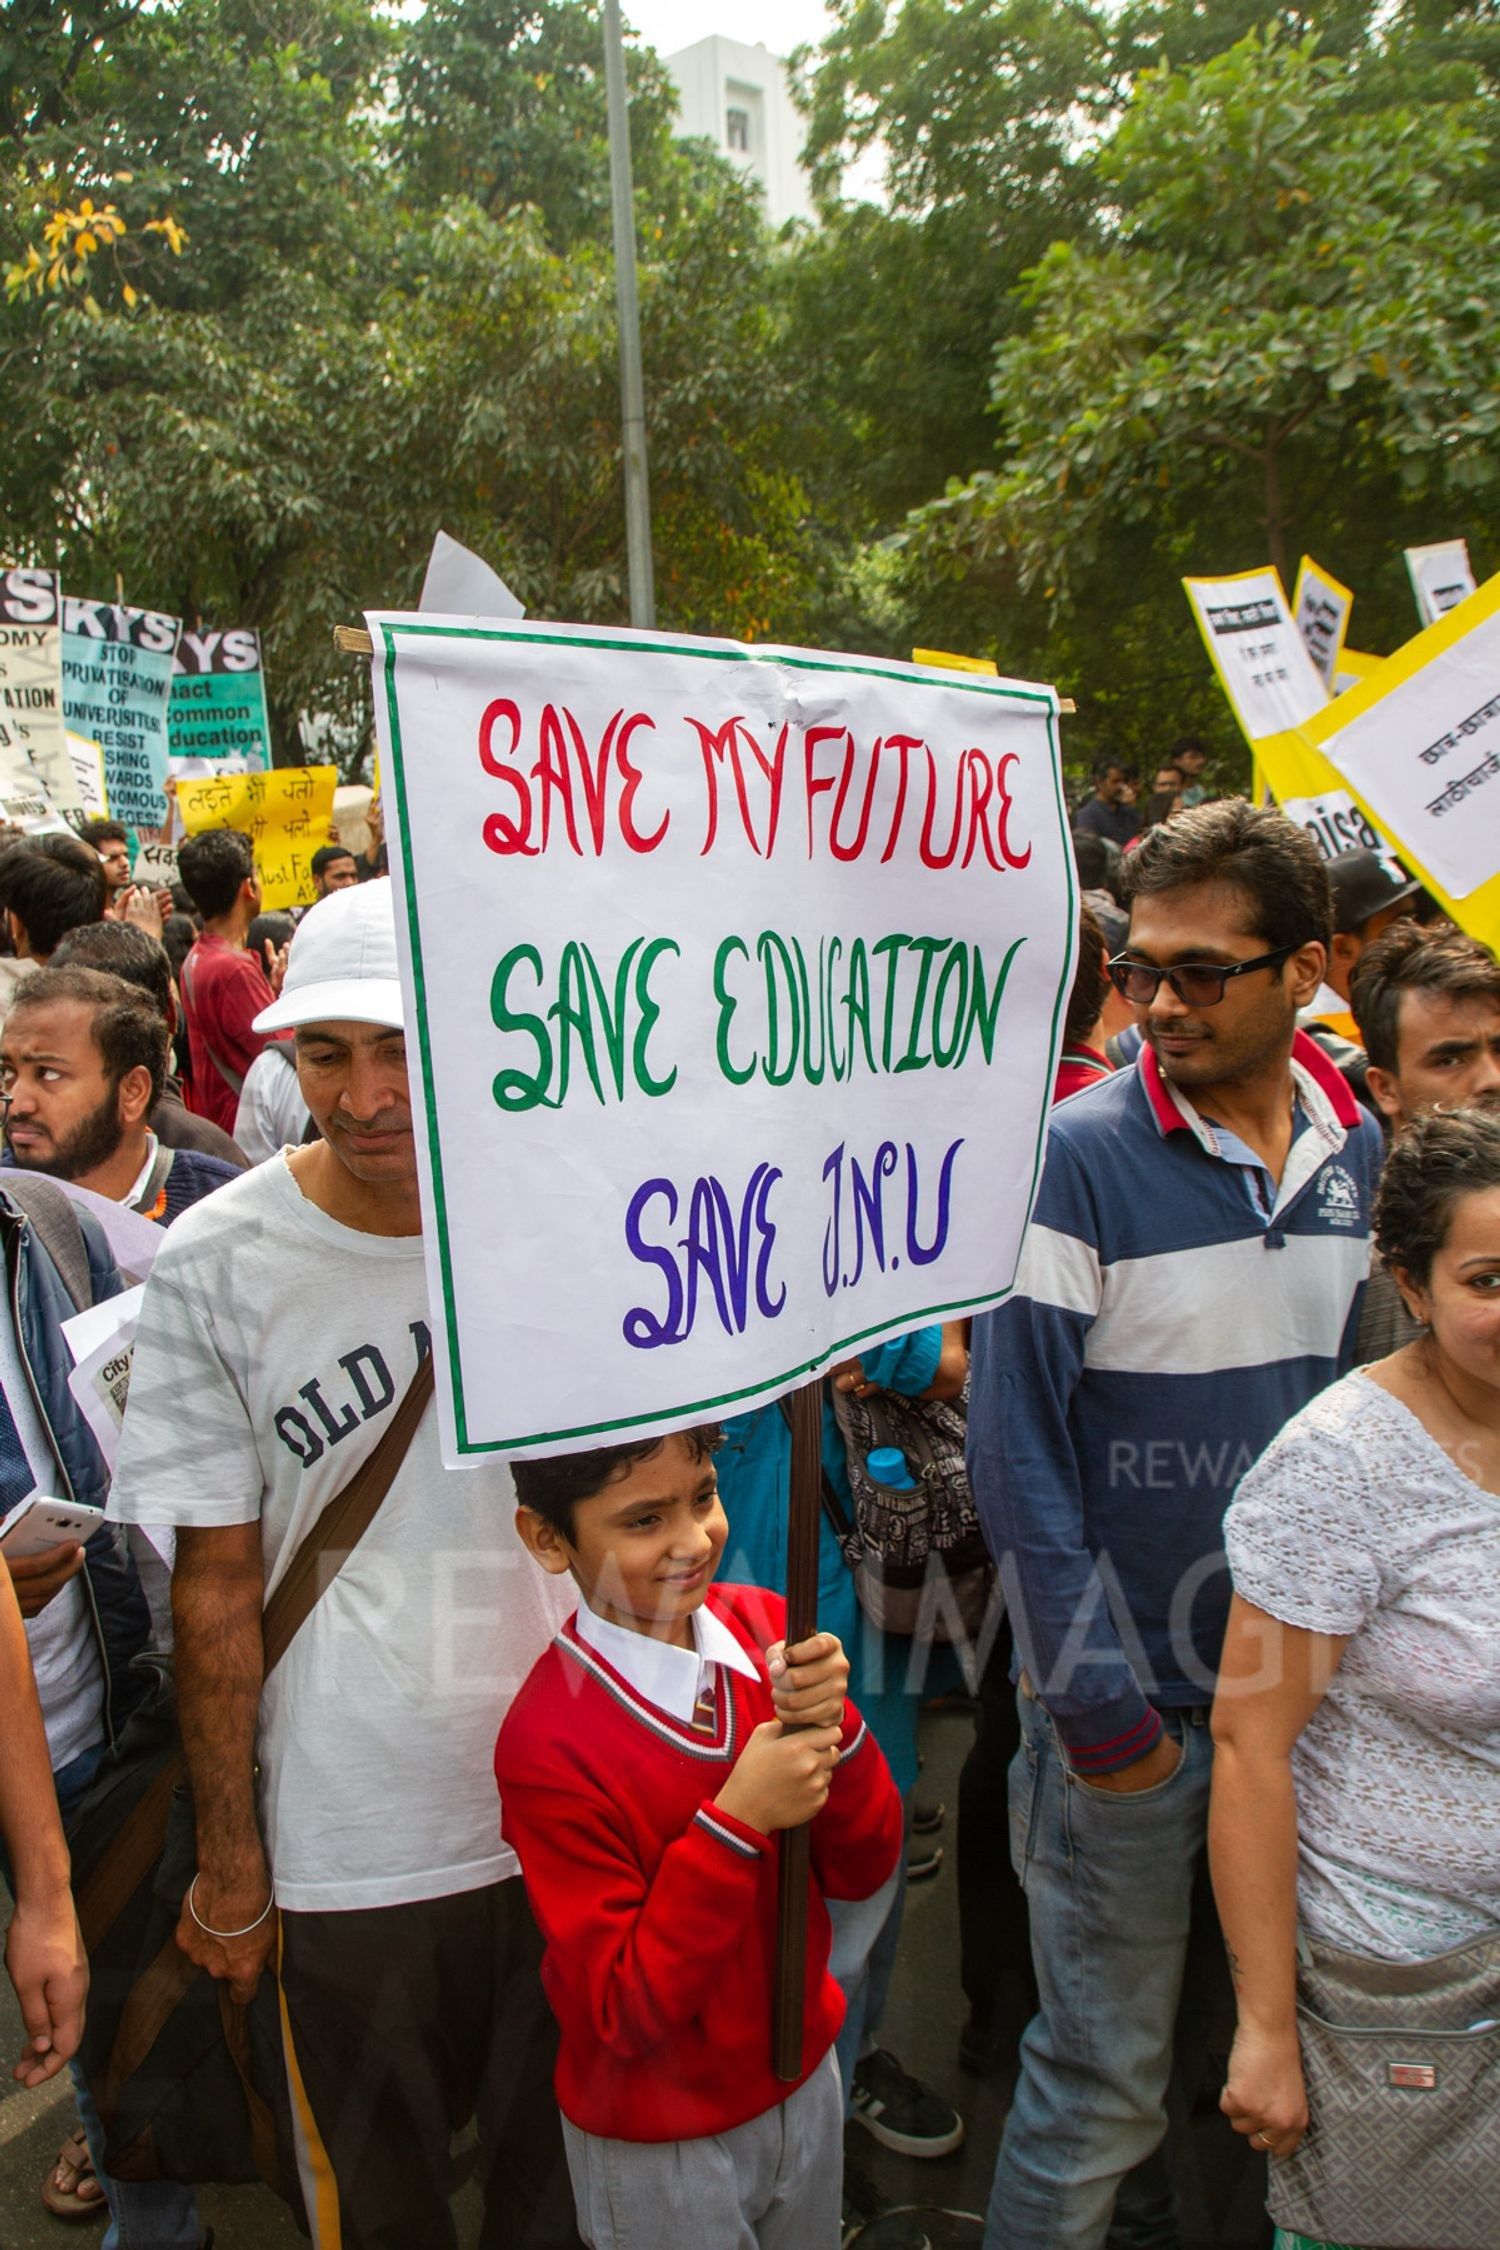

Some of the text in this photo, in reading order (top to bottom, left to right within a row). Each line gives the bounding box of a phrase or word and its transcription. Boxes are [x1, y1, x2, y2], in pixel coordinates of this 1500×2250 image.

[64, 599, 177, 652] KYS
[101, 644, 137, 665] STOP
[109, 687, 128, 706] OF
[92, 728, 146, 750] RESIST
[169, 726, 262, 747] ducation
[105, 749, 150, 770] SHING
[282, 770, 315, 801] चलो
[479, 698, 1032, 872] SAVE MY FUTURE
[490, 930, 1028, 1112] SAVE EDUCATION
[623, 1162, 786, 1349] SAVE
[102, 1354, 130, 1382] City
[273, 1342, 395, 1469] OLD
